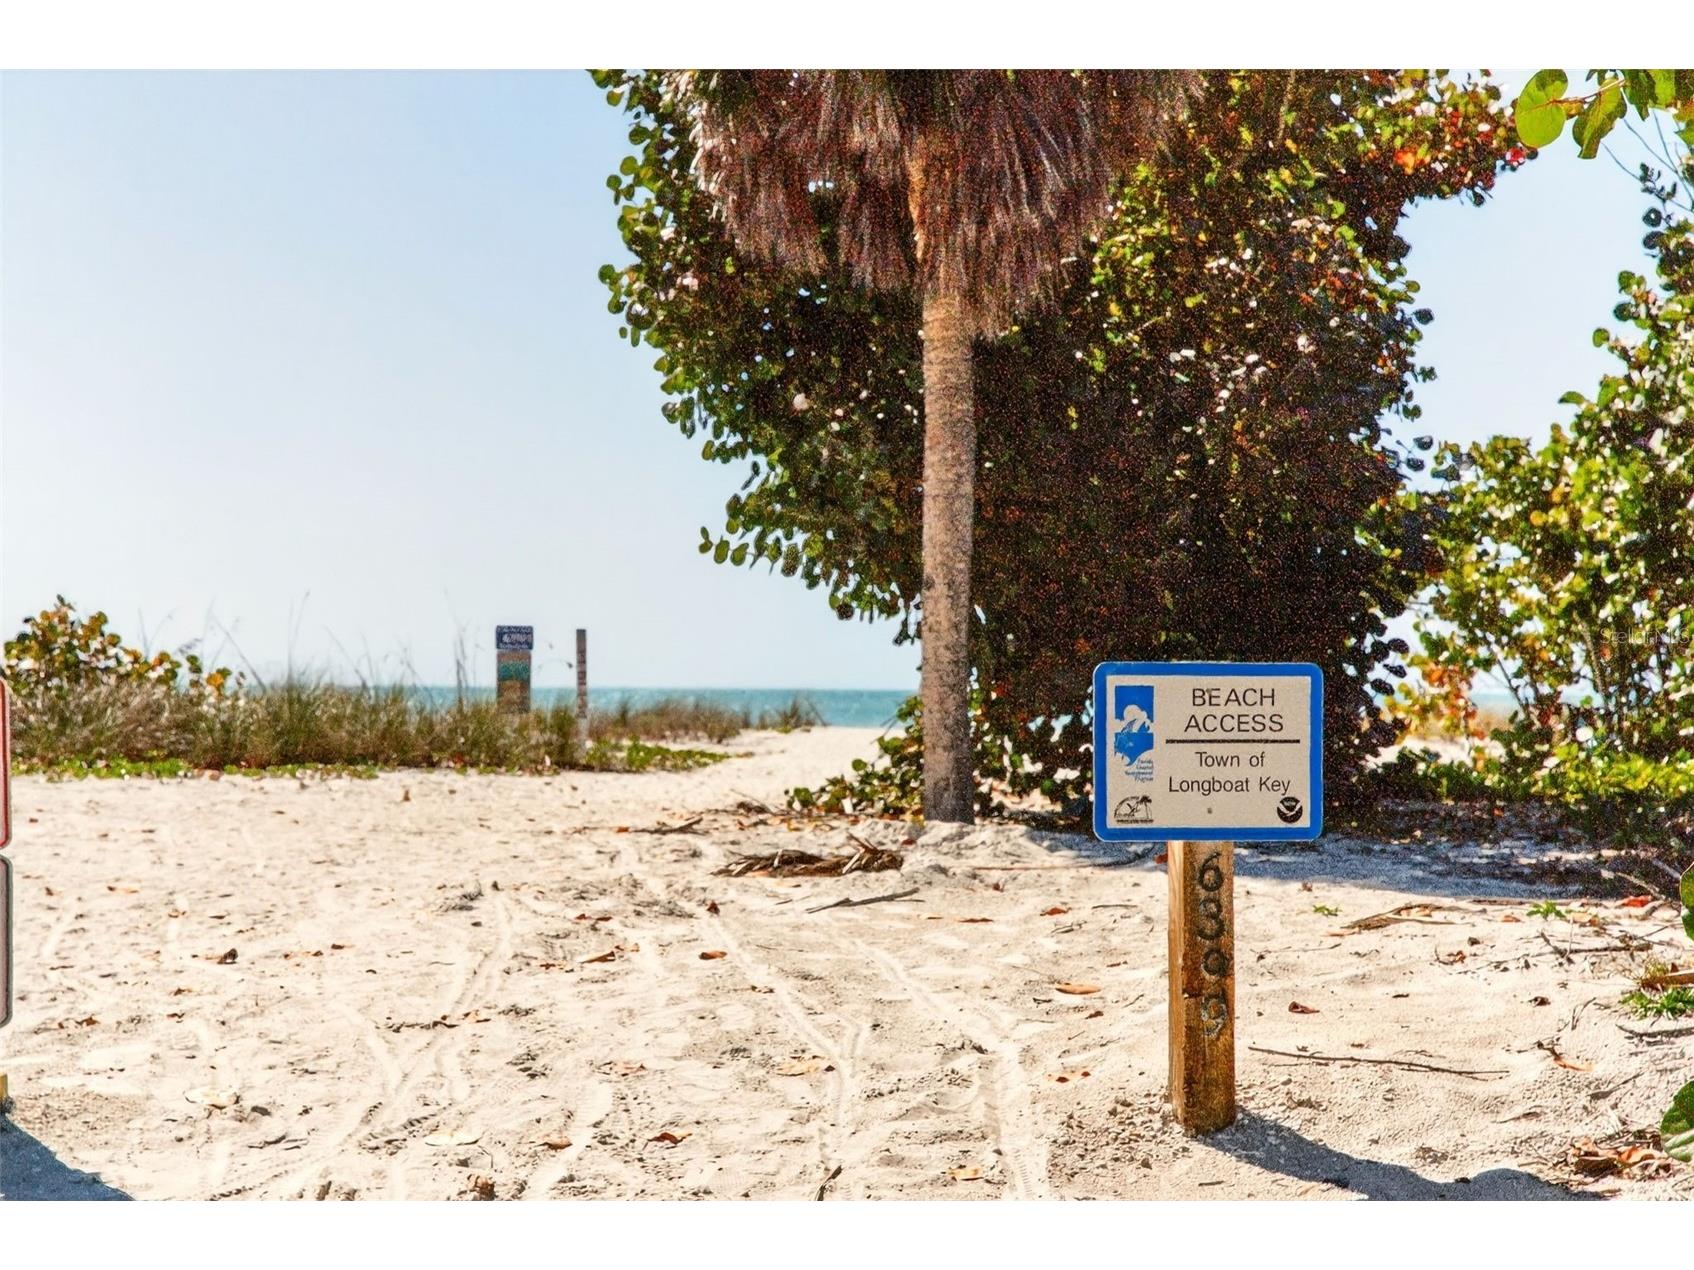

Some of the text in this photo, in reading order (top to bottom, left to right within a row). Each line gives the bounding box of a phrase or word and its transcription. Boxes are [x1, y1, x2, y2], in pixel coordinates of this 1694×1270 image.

[1192, 687, 1275, 707] BEACH
[1184, 713, 1284, 733] ACCESS
[1195, 751, 1266, 768] Town of
[1168, 776, 1291, 796] Longboat Key
